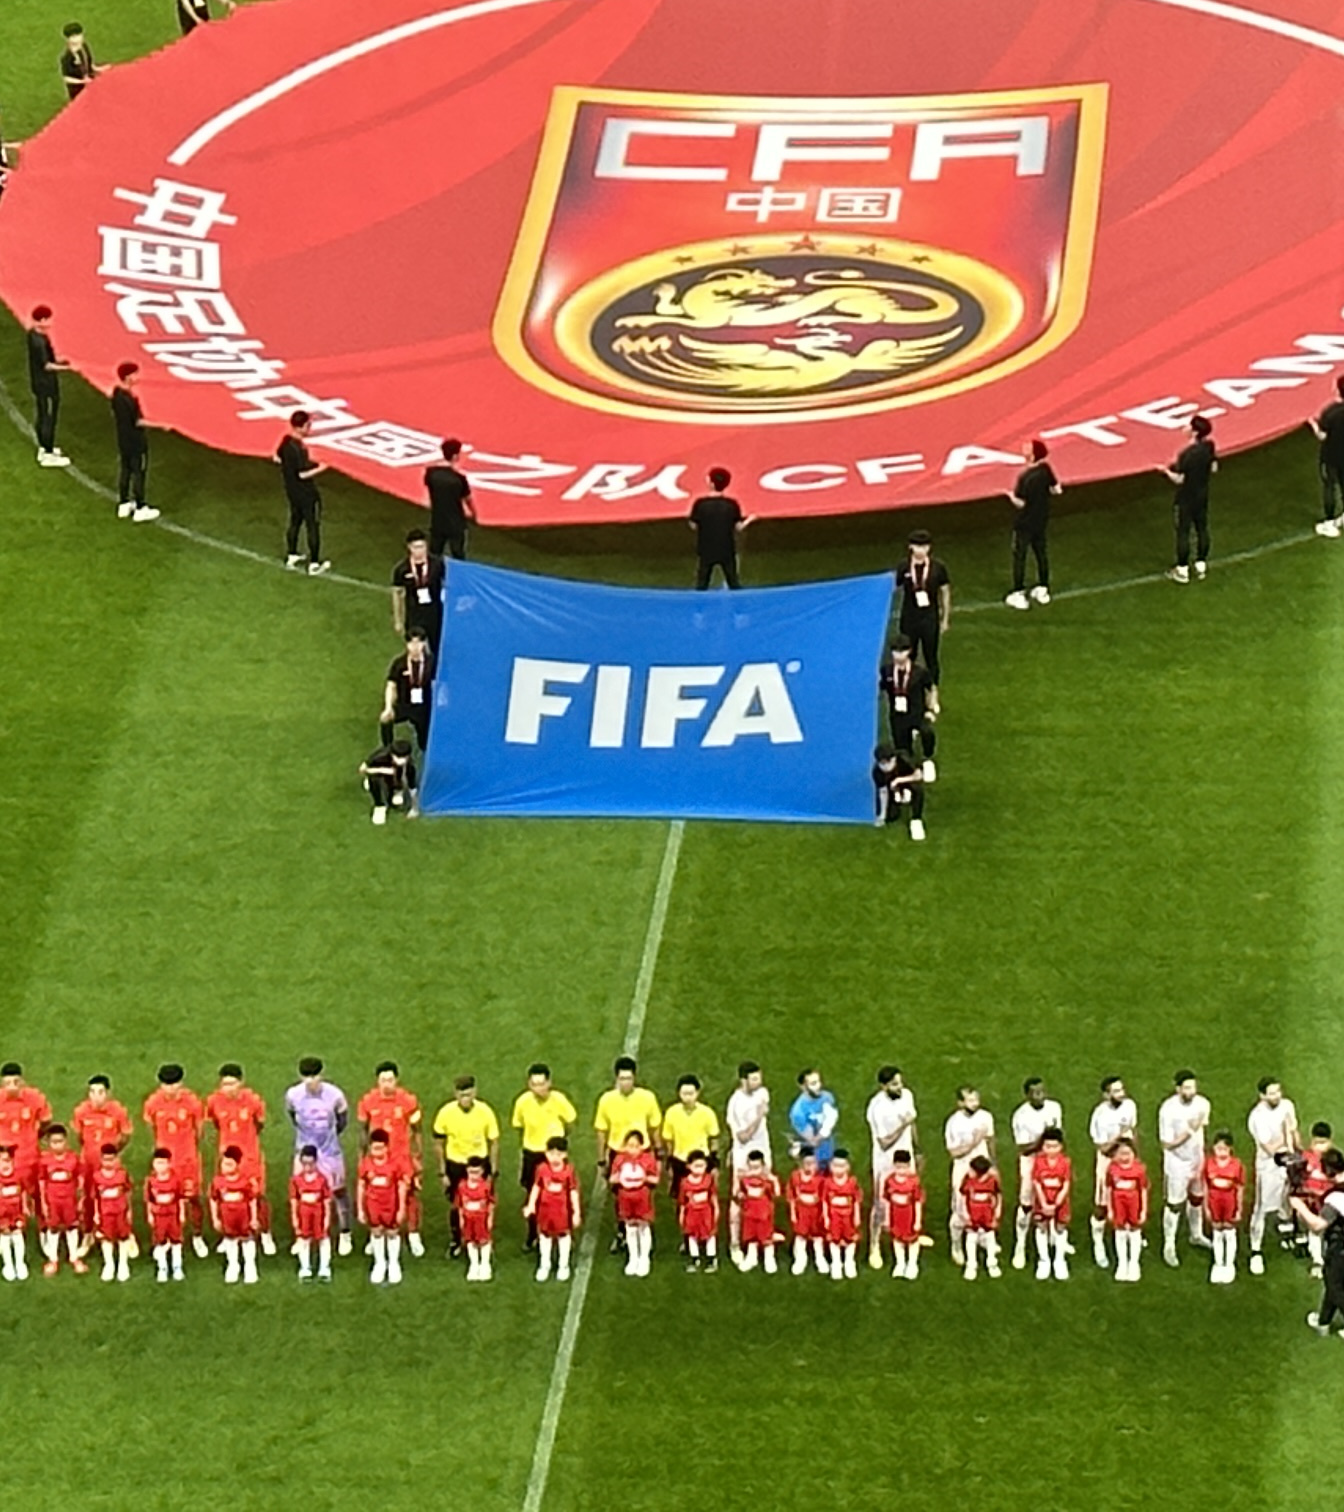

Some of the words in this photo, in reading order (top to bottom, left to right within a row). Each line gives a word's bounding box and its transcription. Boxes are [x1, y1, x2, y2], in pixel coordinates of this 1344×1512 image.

[593, 115, 1050, 183] CFA
[724, 185, 903, 224] 中国
[759, 444, 1027, 492] CFA
[503, 655, 805, 749] FIFA
